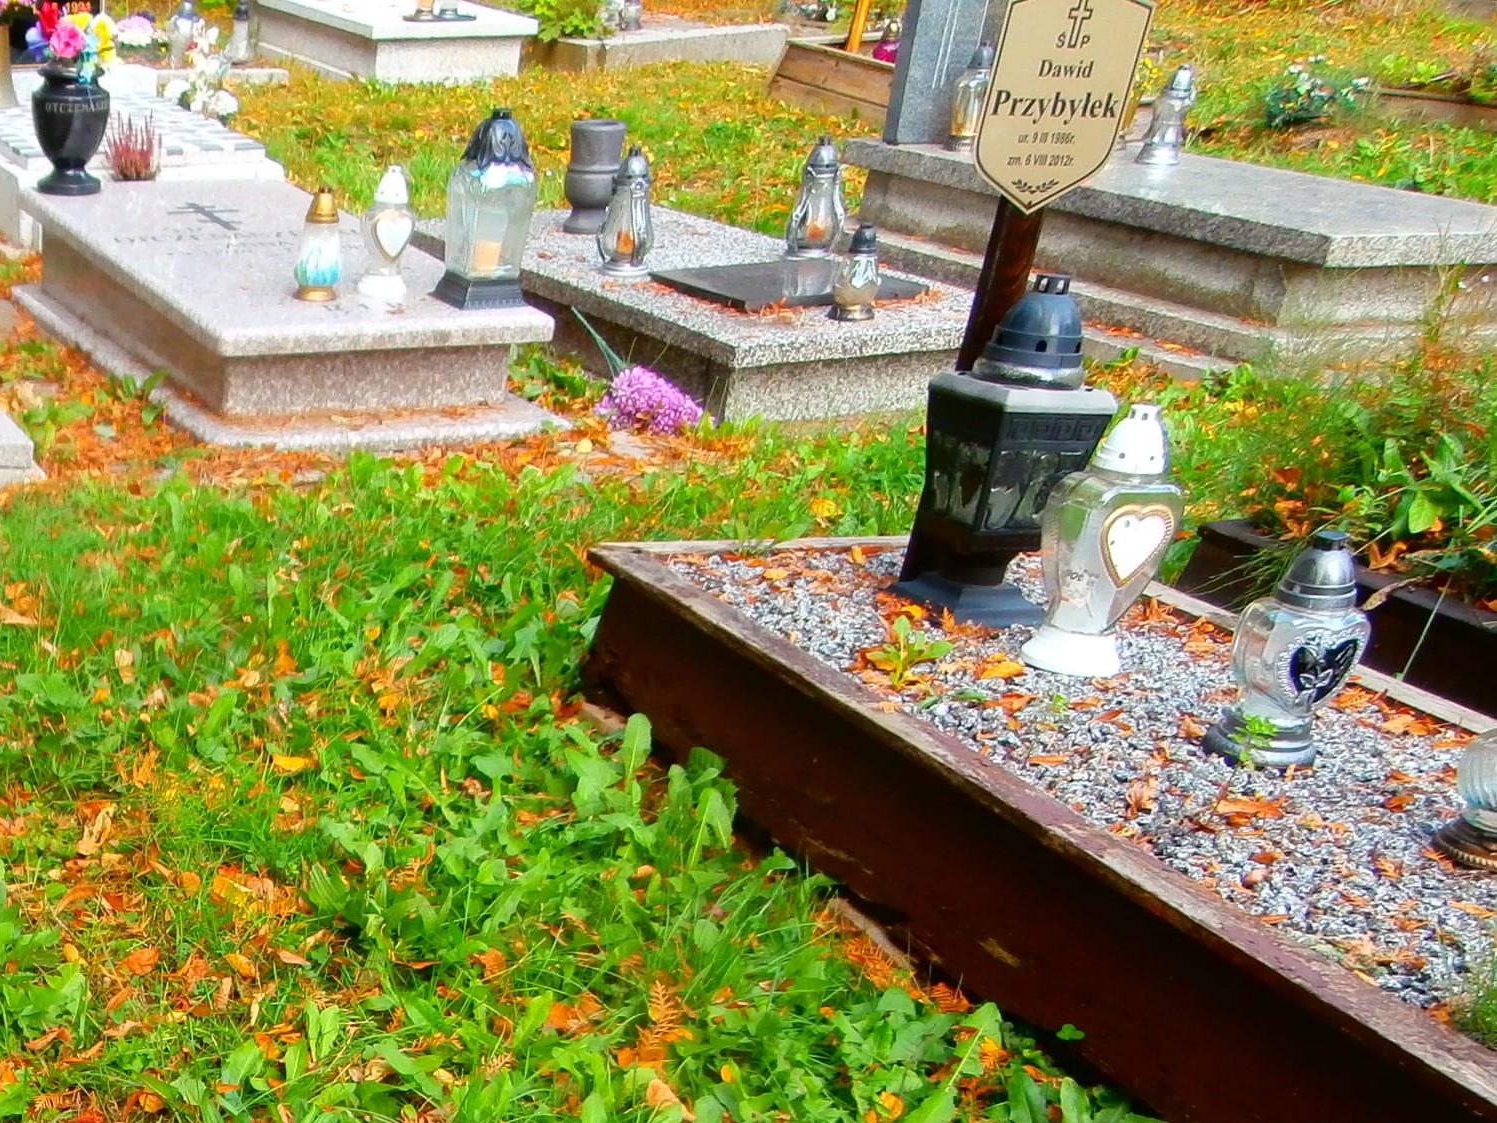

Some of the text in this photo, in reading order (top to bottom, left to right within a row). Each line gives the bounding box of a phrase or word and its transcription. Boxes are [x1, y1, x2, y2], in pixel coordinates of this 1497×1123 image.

[1056, 31, 1090, 48] Ś P
[1038, 59, 1094, 78] Dawid
[991, 89, 1119, 125] Przybyłek
[1017, 134, 1029, 144] ur.
[1032, 131, 1039, 143] 9
[1039, 131, 1049, 144] III
[1006, 153, 1075, 167] zm. 6 VIII 2012r.
